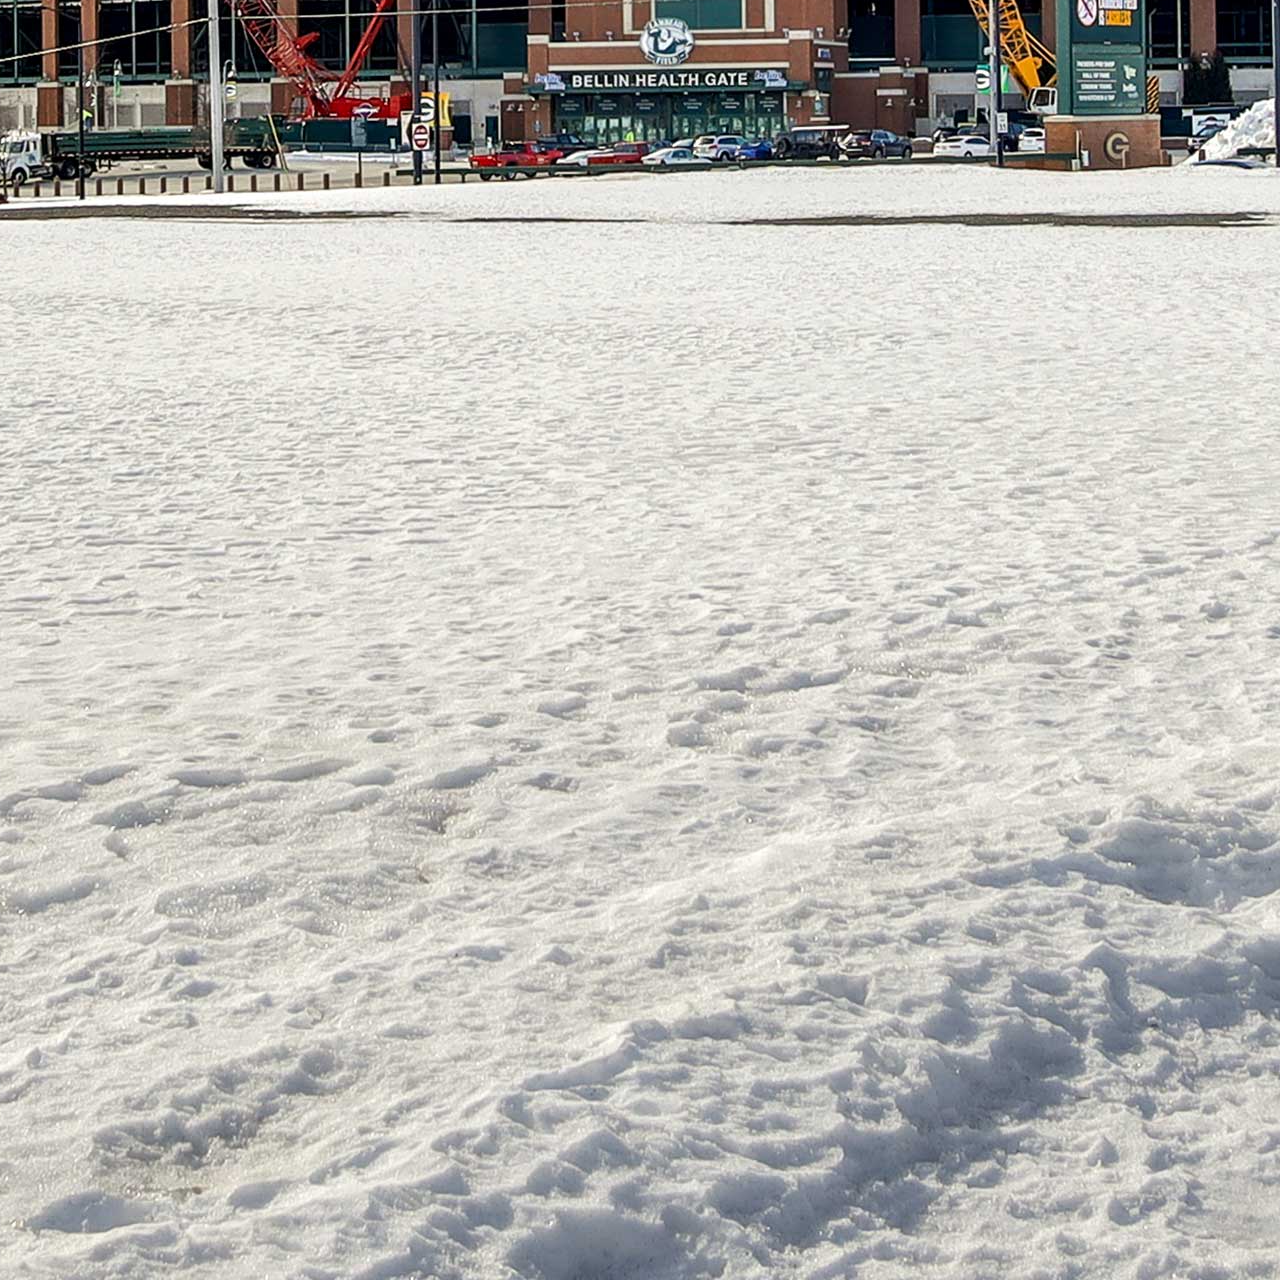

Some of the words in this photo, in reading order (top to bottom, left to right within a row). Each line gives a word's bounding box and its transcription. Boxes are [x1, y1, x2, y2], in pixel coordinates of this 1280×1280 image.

[572, 73, 631, 89] BELLIN
[635, 73, 700, 88] HEALTH
[705, 71, 749, 87] GATE
